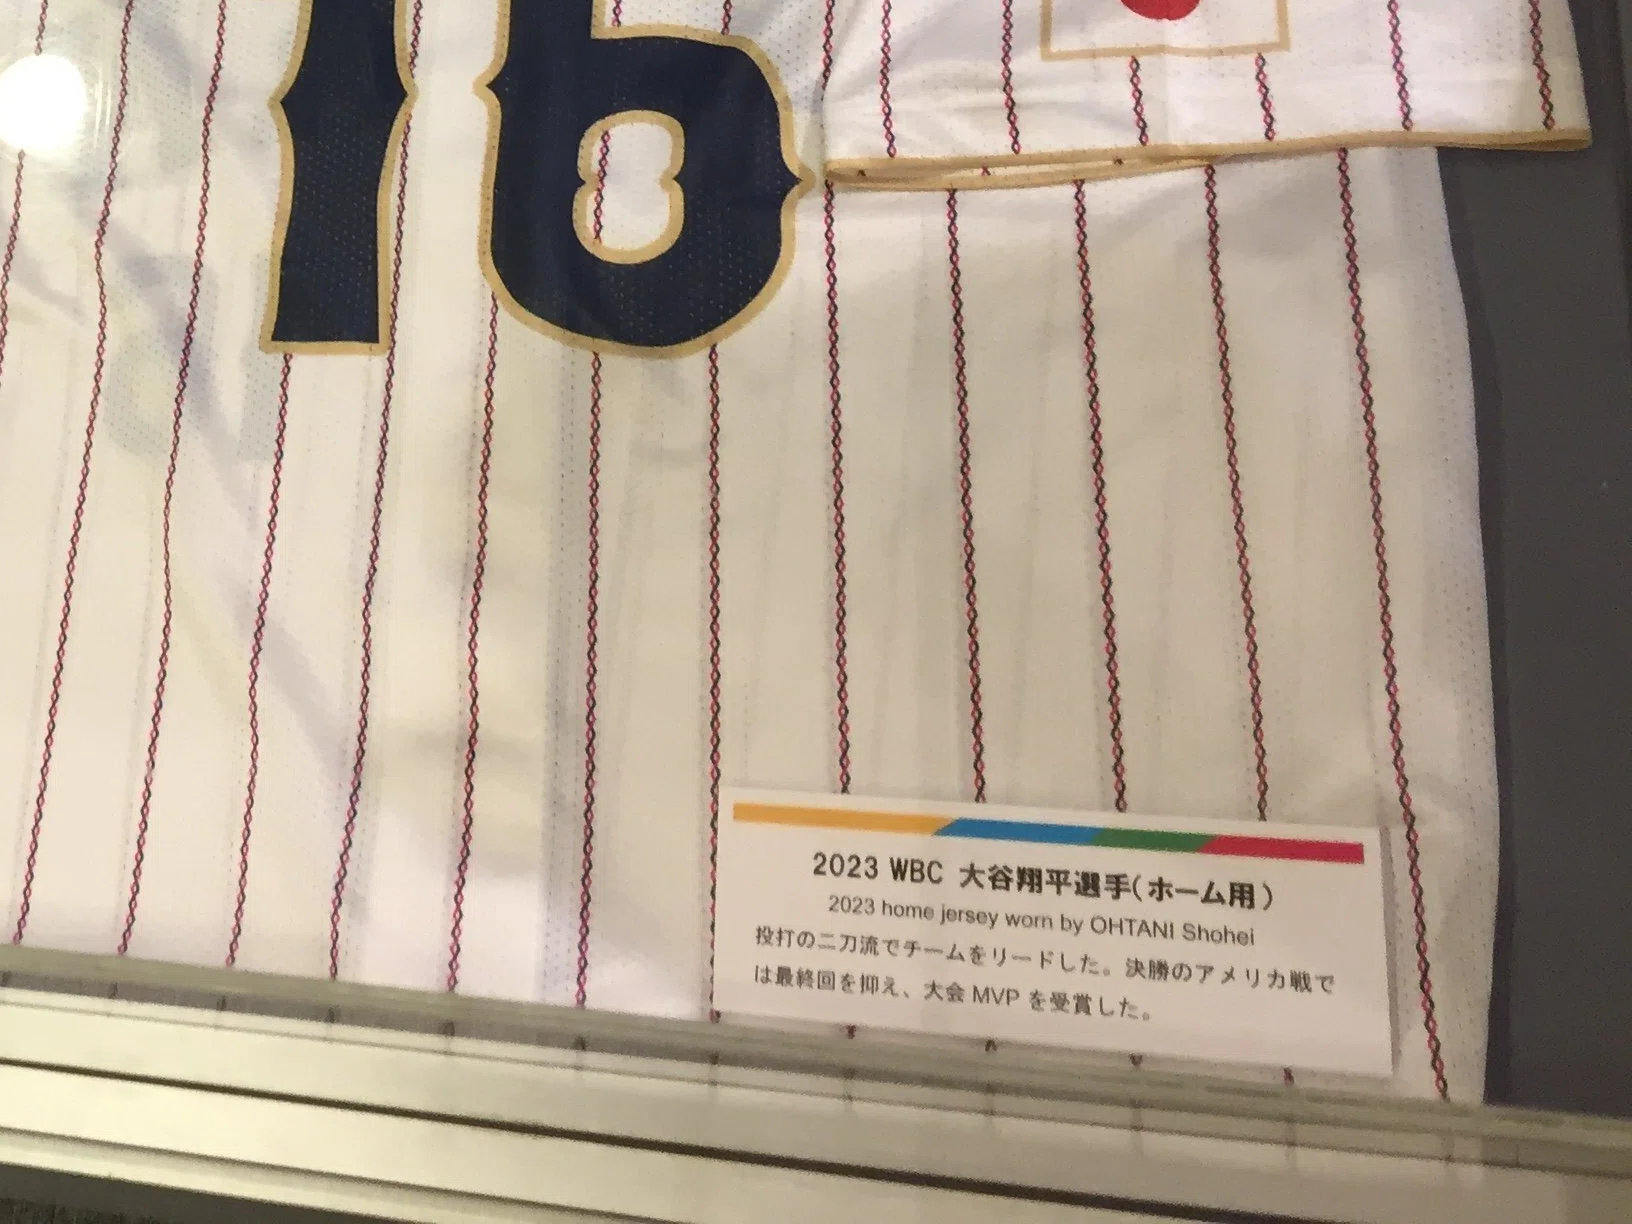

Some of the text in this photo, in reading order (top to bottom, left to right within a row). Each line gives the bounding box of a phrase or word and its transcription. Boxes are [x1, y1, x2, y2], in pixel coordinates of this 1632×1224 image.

[813, 851, 879, 880] 2023
[889, 855, 944, 885] WBC
[828, 894, 1255, 947] 2023 home jersey worn by OHTANI Shohei
[971, 984, 1020, 1007] MVP
